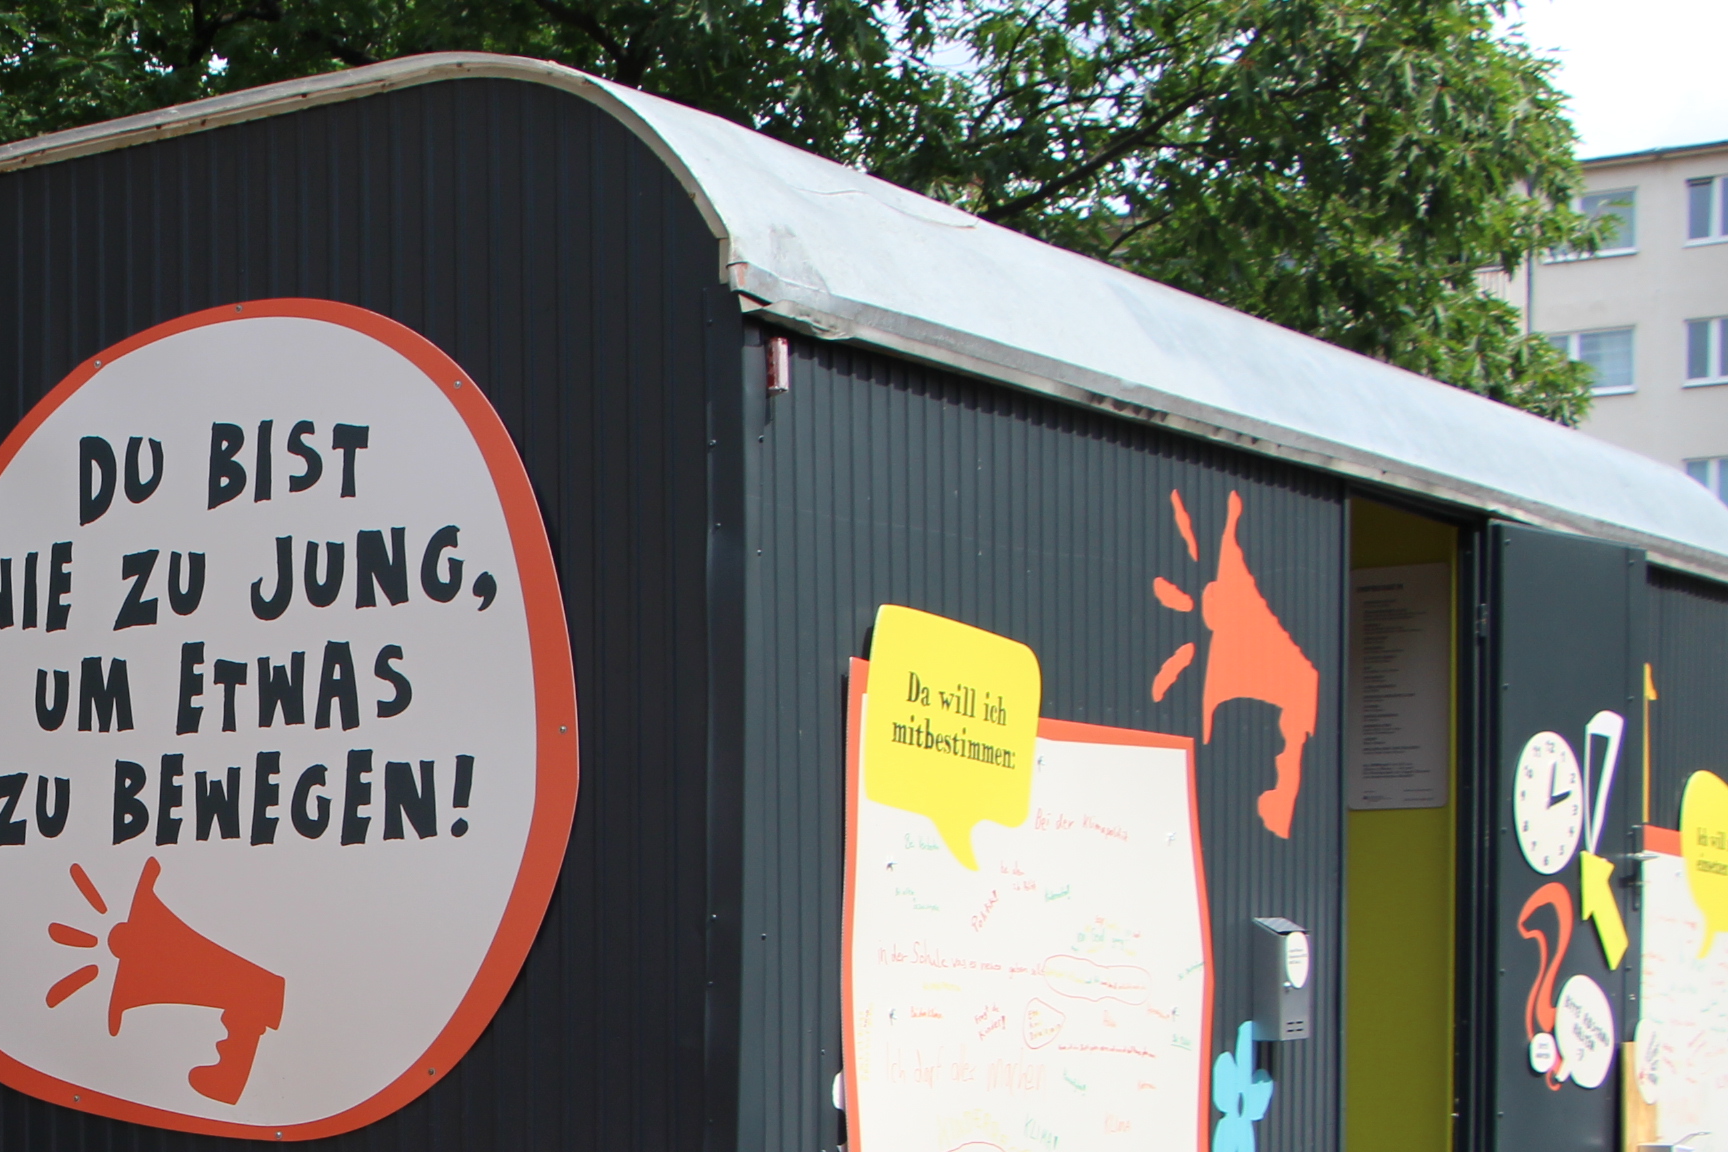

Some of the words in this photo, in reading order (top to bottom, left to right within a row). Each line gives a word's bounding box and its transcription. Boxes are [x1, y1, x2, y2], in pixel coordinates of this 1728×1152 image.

[78, 435, 164, 526] DU
[207, 418, 370, 509] BIST
[113, 549, 206, 631] ZU
[249, 524, 498, 621] JUNG,
[34, 655, 134, 733] UM
[176, 640, 412, 735] ETWAS
[906, 671, 930, 706] Da
[938, 684, 976, 718] will
[984, 693, 1007, 726] ich
[891, 715, 1016, 770] mitbestimmen:
[112, 749, 475, 847] BEWEGEN!
